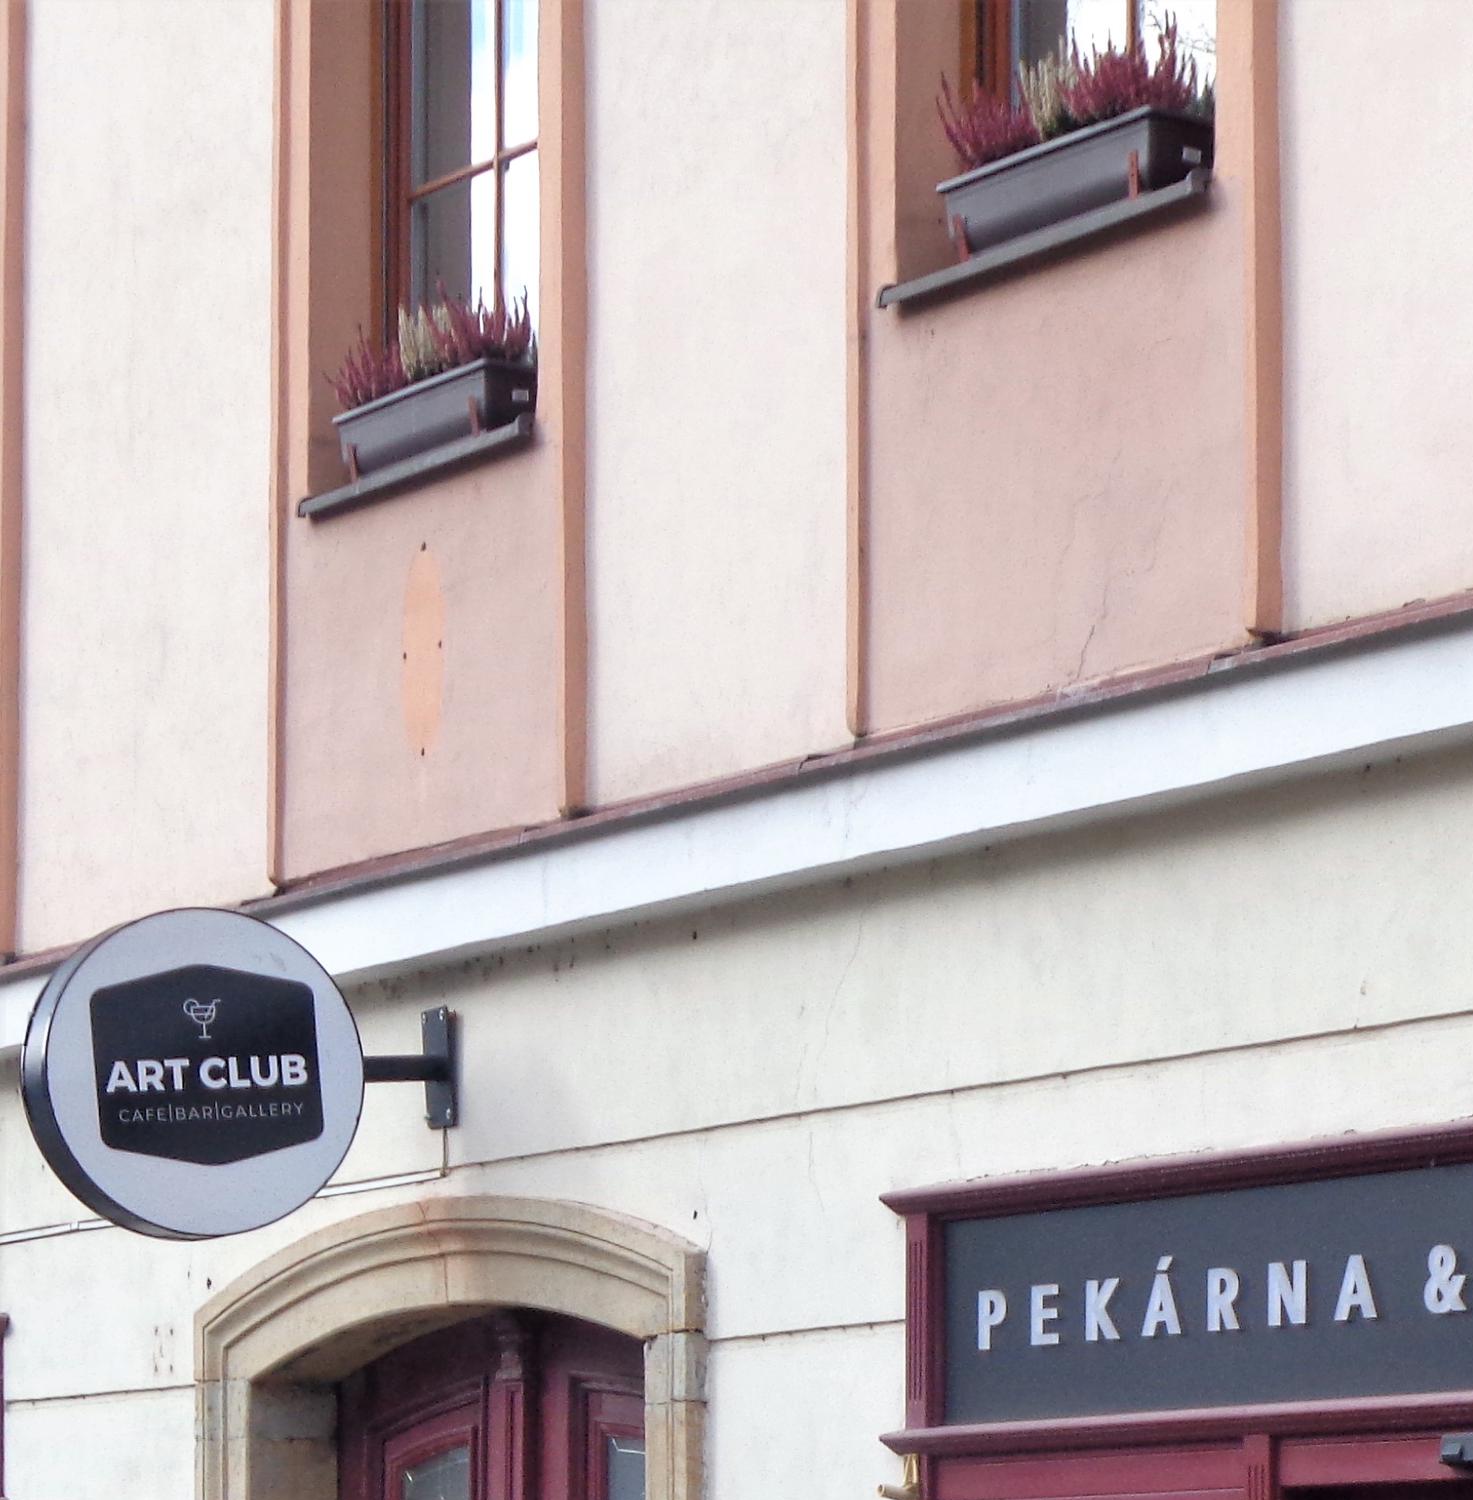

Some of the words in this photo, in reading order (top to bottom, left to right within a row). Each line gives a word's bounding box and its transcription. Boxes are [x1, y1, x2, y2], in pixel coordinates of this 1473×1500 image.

[107, 1058, 190, 1094] ART
[200, 1053, 308, 1088] CLUB
[977, 1254, 1378, 1350] PEKÁRNA
[1423, 1244, 1467, 1314] &
